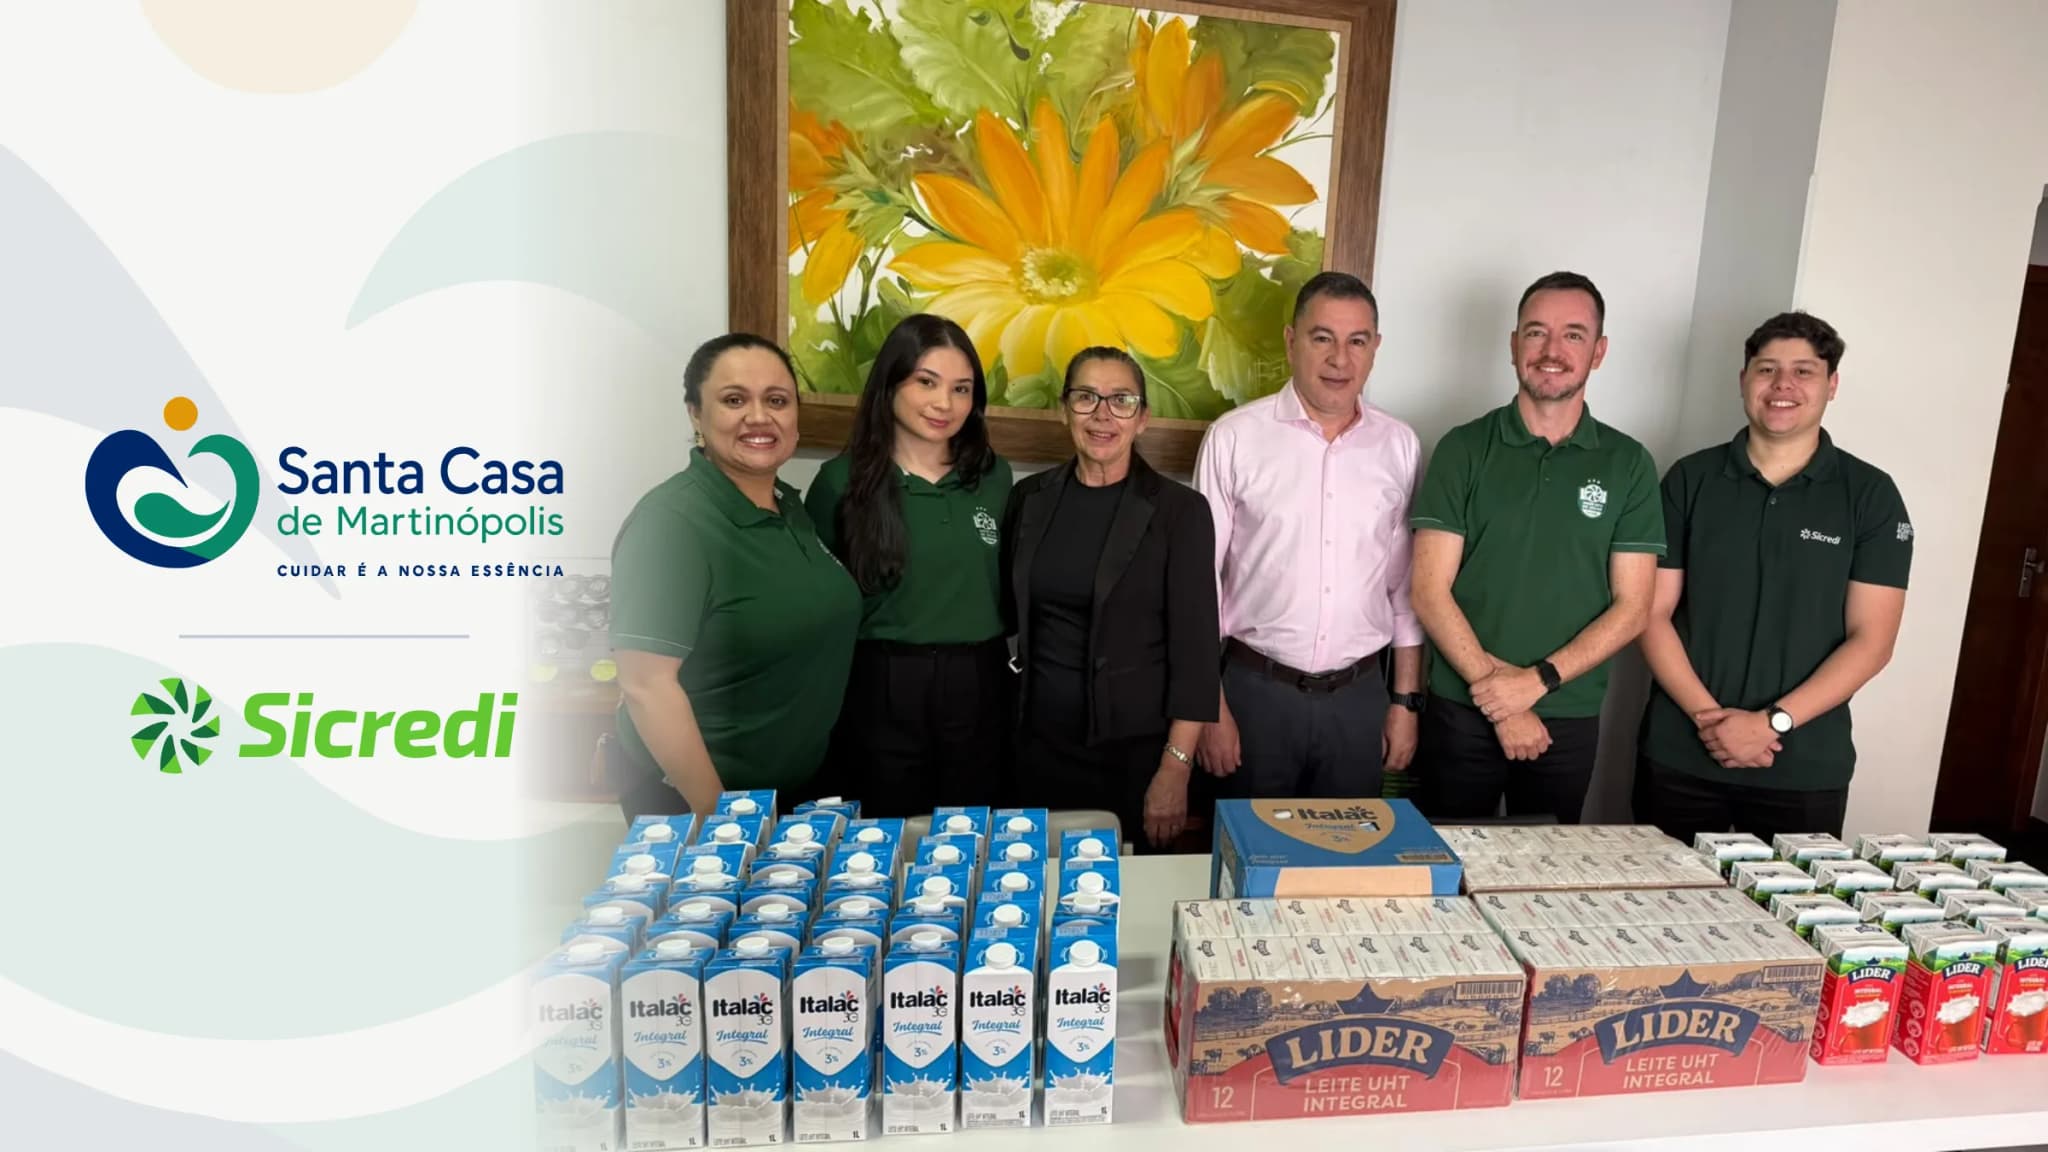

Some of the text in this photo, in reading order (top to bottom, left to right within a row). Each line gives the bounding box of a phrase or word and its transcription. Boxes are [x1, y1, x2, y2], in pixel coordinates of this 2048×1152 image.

[1811, 530, 1841, 545] Sicredi
[1298, 808, 1377, 820] Italac
[1852, 968, 1891, 981] LIDER
[1945, 962, 1981, 977] LIDER
[800, 996, 859, 1014] Italac
[890, 989, 948, 1009] Italac
[970, 989, 1026, 1008] Italac
[1055, 988, 1111, 1005] Italac
[540, 1003, 602, 1022] Italac
[630, 1000, 692, 1018] Italac
[713, 998, 773, 1017] Italac
[893, 1021, 943, 1032] Integral
[972, 1018, 1021, 1031] Integral
[1057, 1017, 1105, 1029] Integral
[1612, 1008, 1740, 1050] LIDER
[633, 1030, 687, 1043] Integral
[716, 1029, 768, 1041] Integral
[802, 1026, 854, 1039] Integral
[1286, 1026, 1432, 1069] LIDER
[1626, 1053, 1719, 1073] LEITE UHT
[1305, 1075, 1410, 1094] LEITE UHT
[1544, 1065, 1564, 1088] 12
[1623, 1071, 1715, 1089] INTEGRAL
[1213, 1086, 1235, 1109] 12
[1303, 1094, 1408, 1113] INTEGRAL
